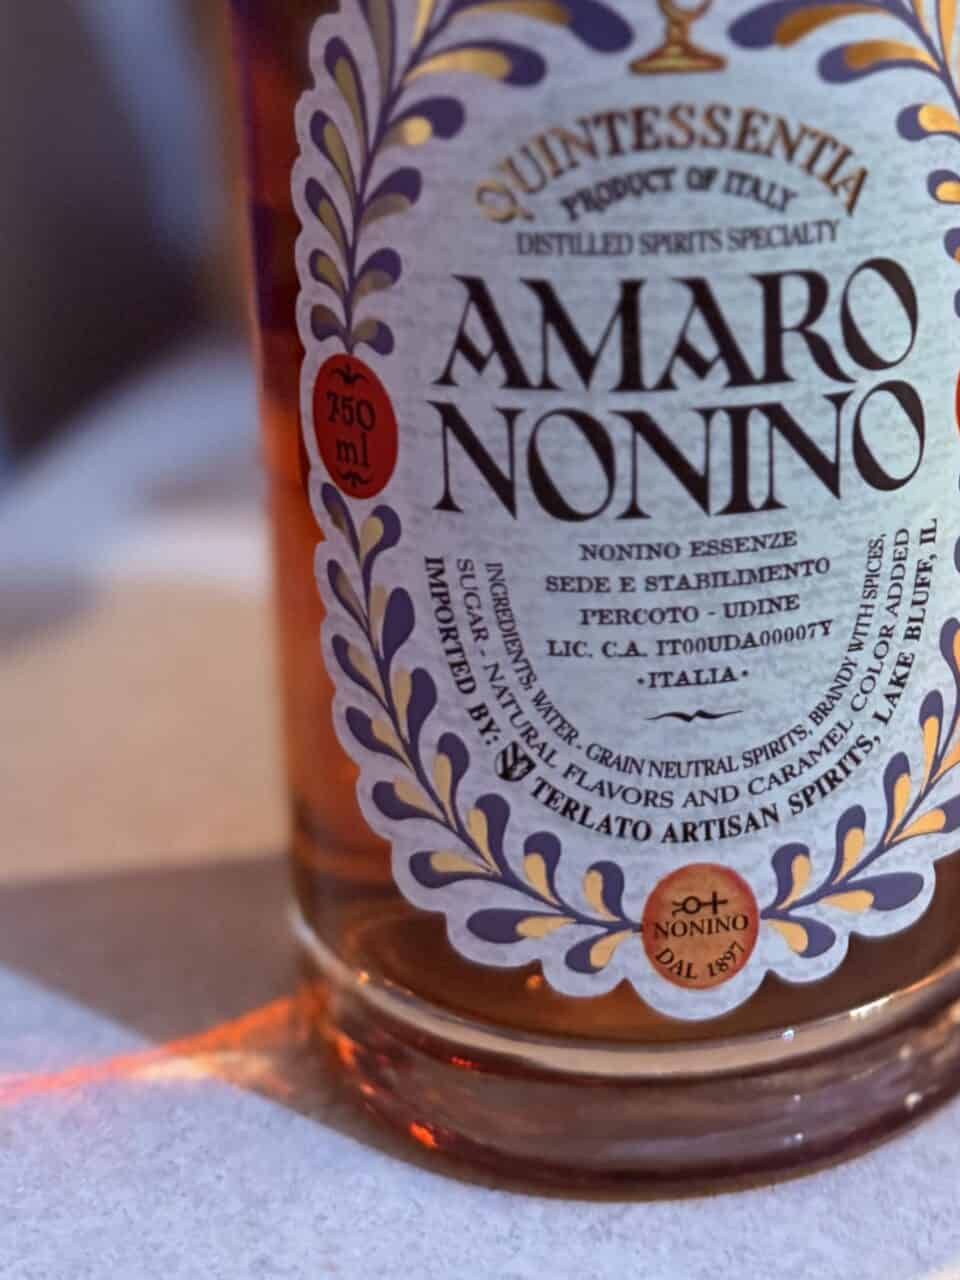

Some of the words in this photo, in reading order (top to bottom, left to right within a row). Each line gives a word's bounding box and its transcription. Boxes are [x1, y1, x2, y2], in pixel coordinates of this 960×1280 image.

[474, 103, 869, 224] QUINTESSENTIA
[559, 167, 678, 221] PRODUCT
[685, 166, 718, 193] OF
[724, 169, 800, 213] ITALY
[515, 231, 634, 257] DISTILLED
[639, 227, 723, 255] SPIRITS
[727, 219, 840, 252] SPECIALTY
[431, 257, 919, 394] AMARO
[326, 391, 376, 432] 750
[335, 431, 370, 468] ml
[426, 379, 926, 522] NONINO
[578, 542, 681, 562] NONINO
[689, 530, 798, 558] ESSENZE
[919, 518, 938, 546] IL
[545, 576, 611, 594] SEDE
[620, 576, 636, 593] E
[645, 557, 830, 593] STABILIMENTO
[903, 553, 938, 641] BLUFF,
[425, 555, 478, 696] IMPORTED
[580, 605, 699, 626] PERCOTO
[723, 593, 801, 619] UDINE
[456, 557, 489, 643] SUGAR
[483, 661, 560, 768] NATURAL
[562, 763, 675, 809] FLAVORS
[681, 784, 740, 809] AND
[747, 719, 855, 797] CARAMEL
[850, 624, 896, 713] COLOR
[885, 528, 911, 617] ADDED
[546, 639, 593, 658] LIC.
[601, 640, 648, 658] C.A.
[531, 688, 580, 746] WATER
[585, 742, 639, 777] GRAIN
[648, 755, 739, 780] NEUTRAL
[808, 656, 858, 726] BRANDY
[847, 604, 876, 654] WITH
[872, 651, 915, 726] LAKE
[467, 702, 500, 746] BY:
[787, 733, 882, 816] SPIRITS,
[530, 775, 653, 843] TERLATO
[660, 803, 780, 844] ARTISAN
[654, 914, 750, 940] NONINO
[655, 947, 699, 980] DAL
[707, 940, 746, 978] 1897
